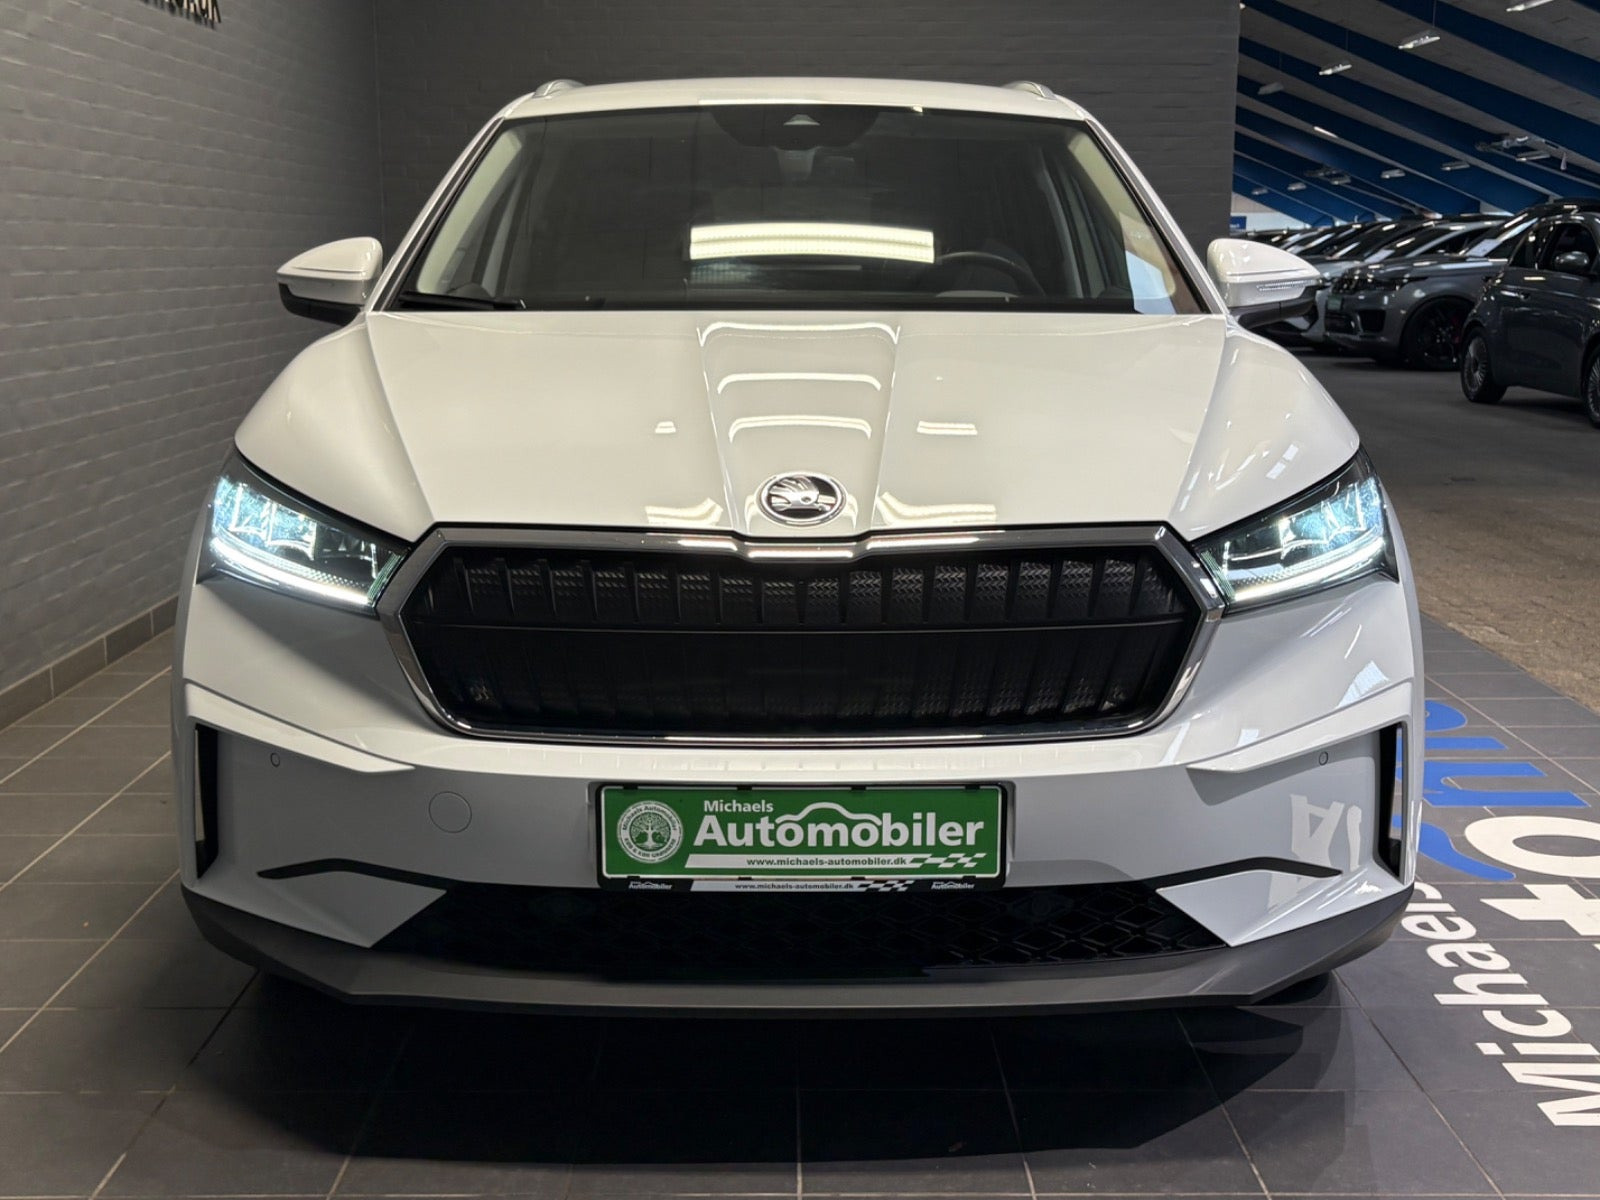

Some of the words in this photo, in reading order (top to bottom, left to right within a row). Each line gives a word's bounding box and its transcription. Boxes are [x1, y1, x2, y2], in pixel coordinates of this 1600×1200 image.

[704, 800, 774, 813] Michaels
[693, 812, 985, 848] Automobiler
[746, 857, 907, 866] www.michaels-automobiler.dk
